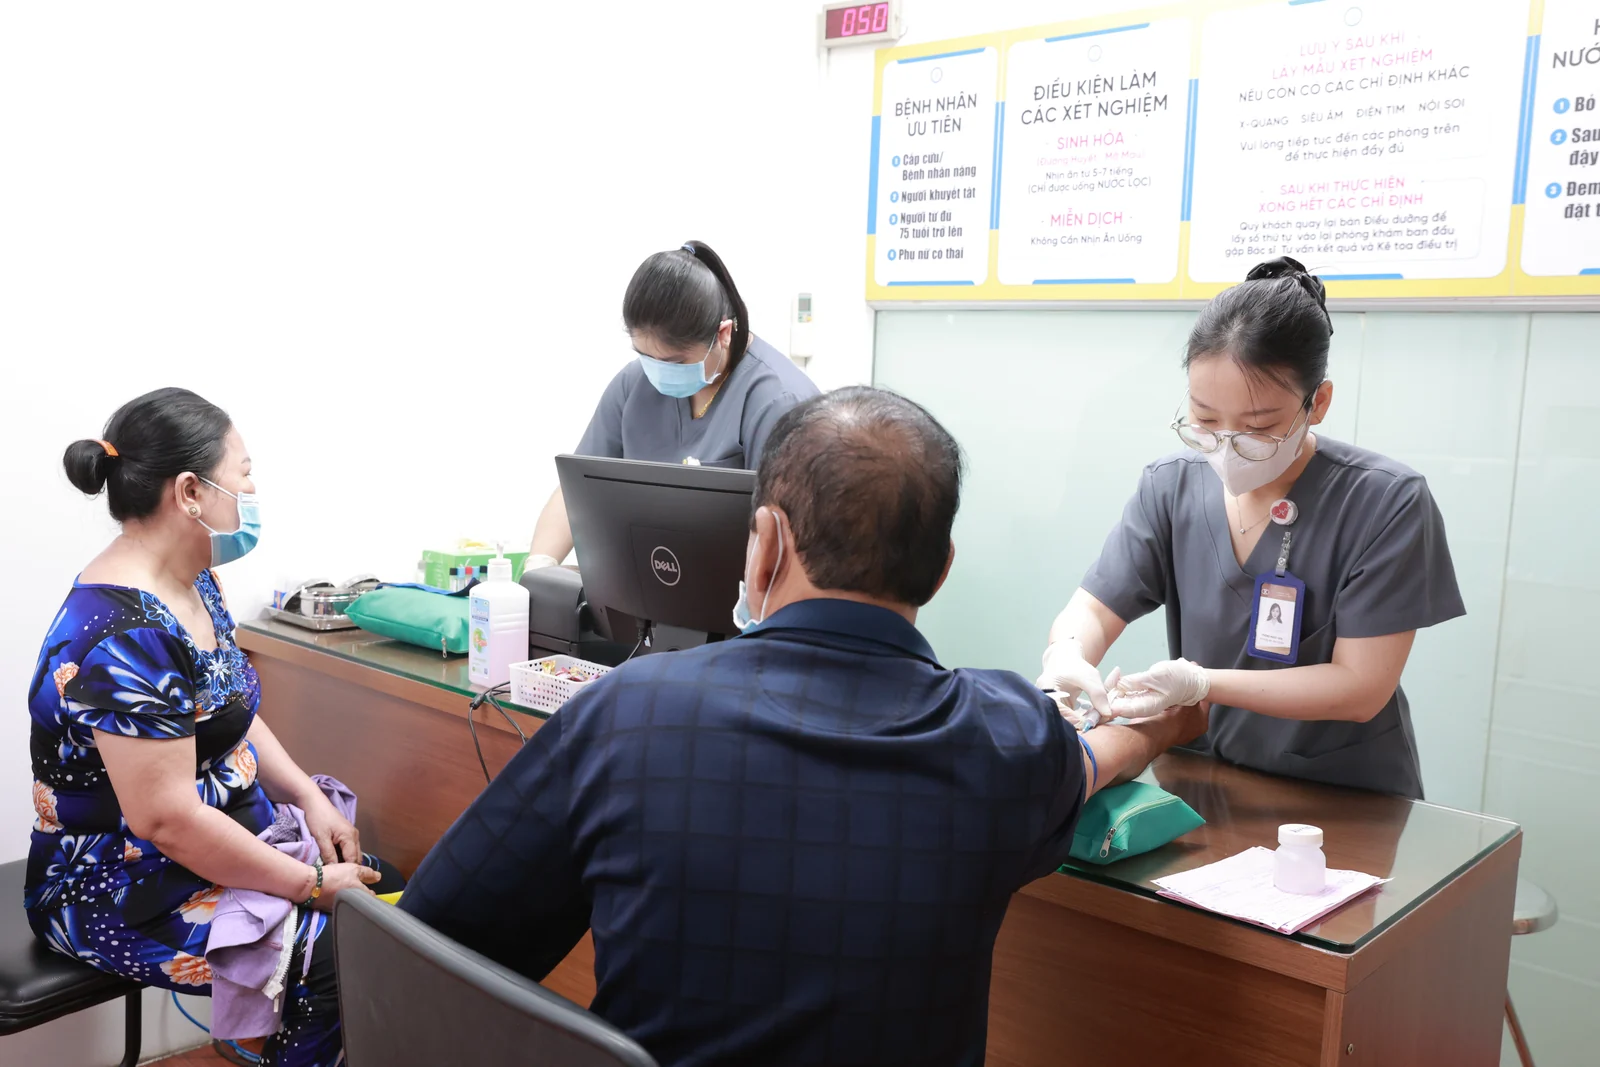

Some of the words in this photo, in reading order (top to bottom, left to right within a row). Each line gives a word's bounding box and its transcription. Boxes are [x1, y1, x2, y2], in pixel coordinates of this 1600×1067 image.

[841, 3, 888, 36] 050
[1346, 35, 1374, 51] SAU
[1380, 29, 1405, 46] KHI
[1371, 48, 1433, 69] NGHIỆM
[1077, 74, 1114, 98] KIỆN
[1121, 69, 1156, 91] LÀM
[1388, 72, 1423, 89] ĐỊNH
[1428, 64, 1470, 82] KHÁC
[895, 97, 931, 119] BỆNH
[936, 91, 977, 112] NHÂN
[1021, 104, 1057, 125] CÁC
[1063, 100, 1092, 121] XÉT
[1098, 92, 1167, 117] NGHIỆM
[1301, 111, 1323, 124] SIÊU
[1386, 104, 1405, 115] TIM
[1444, 98, 1465, 110] SOI
[931, 115, 961, 134] TIÊN
[1057, 135, 1089, 150] SINH
[1240, 140, 1257, 151] Vui
[1288, 135, 1310, 148] tiếp
[1433, 122, 1460, 135] trên
[1571, 127, 1600, 143] Sau
[1332, 147, 1358, 160] hiện
[1569, 149, 1599, 168] đậy
[1093, 167, 1107, 177] 5-7
[1109, 165, 1133, 177] tiếng
[1072, 180, 1095, 192] uống
[1280, 183, 1305, 195] SAU
[1308, 182, 1330, 193] KHI
[1333, 178, 1369, 194] THỰC
[1374, 174, 1405, 192] HIỆN
[1566, 181, 1600, 197] Đem
[1259, 200, 1296, 213] XONG
[1388, 193, 1423, 209] ĐỊNH
[1564, 203, 1590, 221] đặt
[1050, 207, 1083, 227] MIỄN
[1088, 211, 1123, 228] DỊCH
[1295, 220, 1321, 230] quay
[899, 227, 910, 240] 75
[948, 225, 963, 238] lên
[1030, 236, 1058, 247] Không
[1081, 234, 1100, 246] Nhịn
[1103, 231, 1115, 243] Ăn
[1117, 231, 1143, 245] Uống
[1406, 227, 1429, 237] ban
[945, 247, 964, 260] thai
[1394, 242, 1413, 251] toa
[654, 560, 677, 572] DELL
